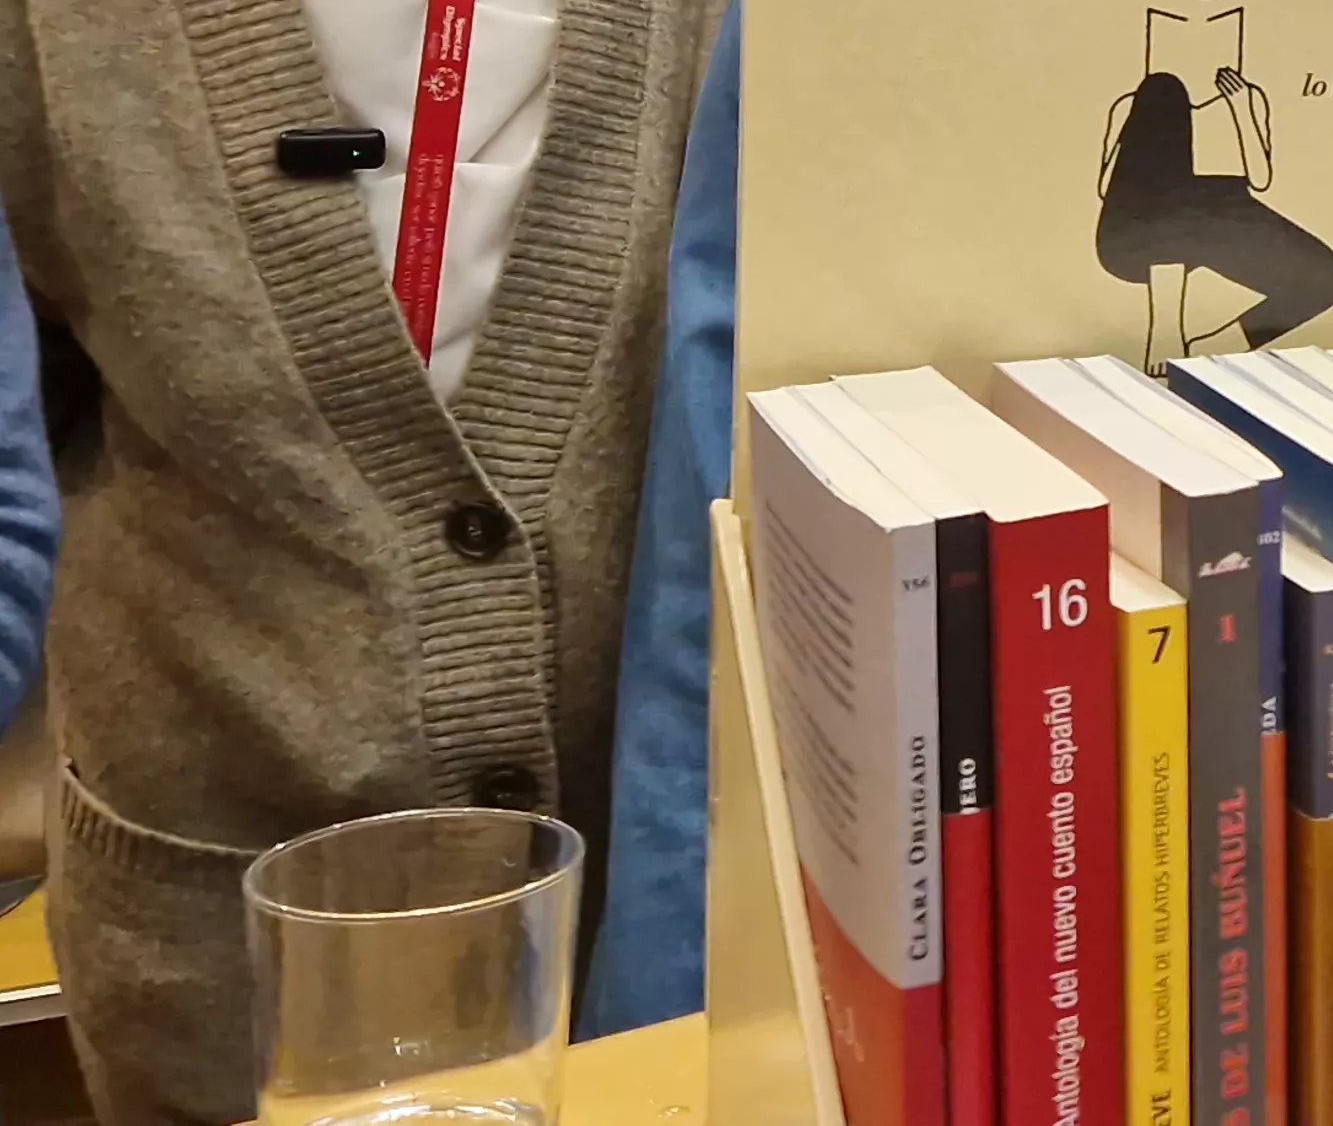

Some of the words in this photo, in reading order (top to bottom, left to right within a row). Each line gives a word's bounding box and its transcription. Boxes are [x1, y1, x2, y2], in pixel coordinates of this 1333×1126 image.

[440, 5, 456, 61] Olympics
[452, 17, 467, 62] Special
[1301, 71, 1328, 98] lo
[1032, 578, 1089, 632] 16
[1217, 614, 1237, 643] 1
[1147, 625, 1172, 664] 7
[1042, 684, 1078, 785] español
[907, 735, 928, 866] OBLIGADO
[1049, 790, 1076, 879] cuento
[1152, 751, 1172, 867] HIPERBREVES
[1210, 787, 1249, 939] BUÑUEL
[908, 877, 930, 962] CLARA
[1049, 884, 1078, 963] nuevo
[1152, 870, 1172, 944] RELATOS
[1049, 968, 1079, 1009] del
[1153, 950, 1172, 971] DE
[1218, 948, 1250, 1035] LUIS
[1152, 976, 1172, 1073] ANTOLOGÍA
[1219, 1043, 1250, 1099] DE
